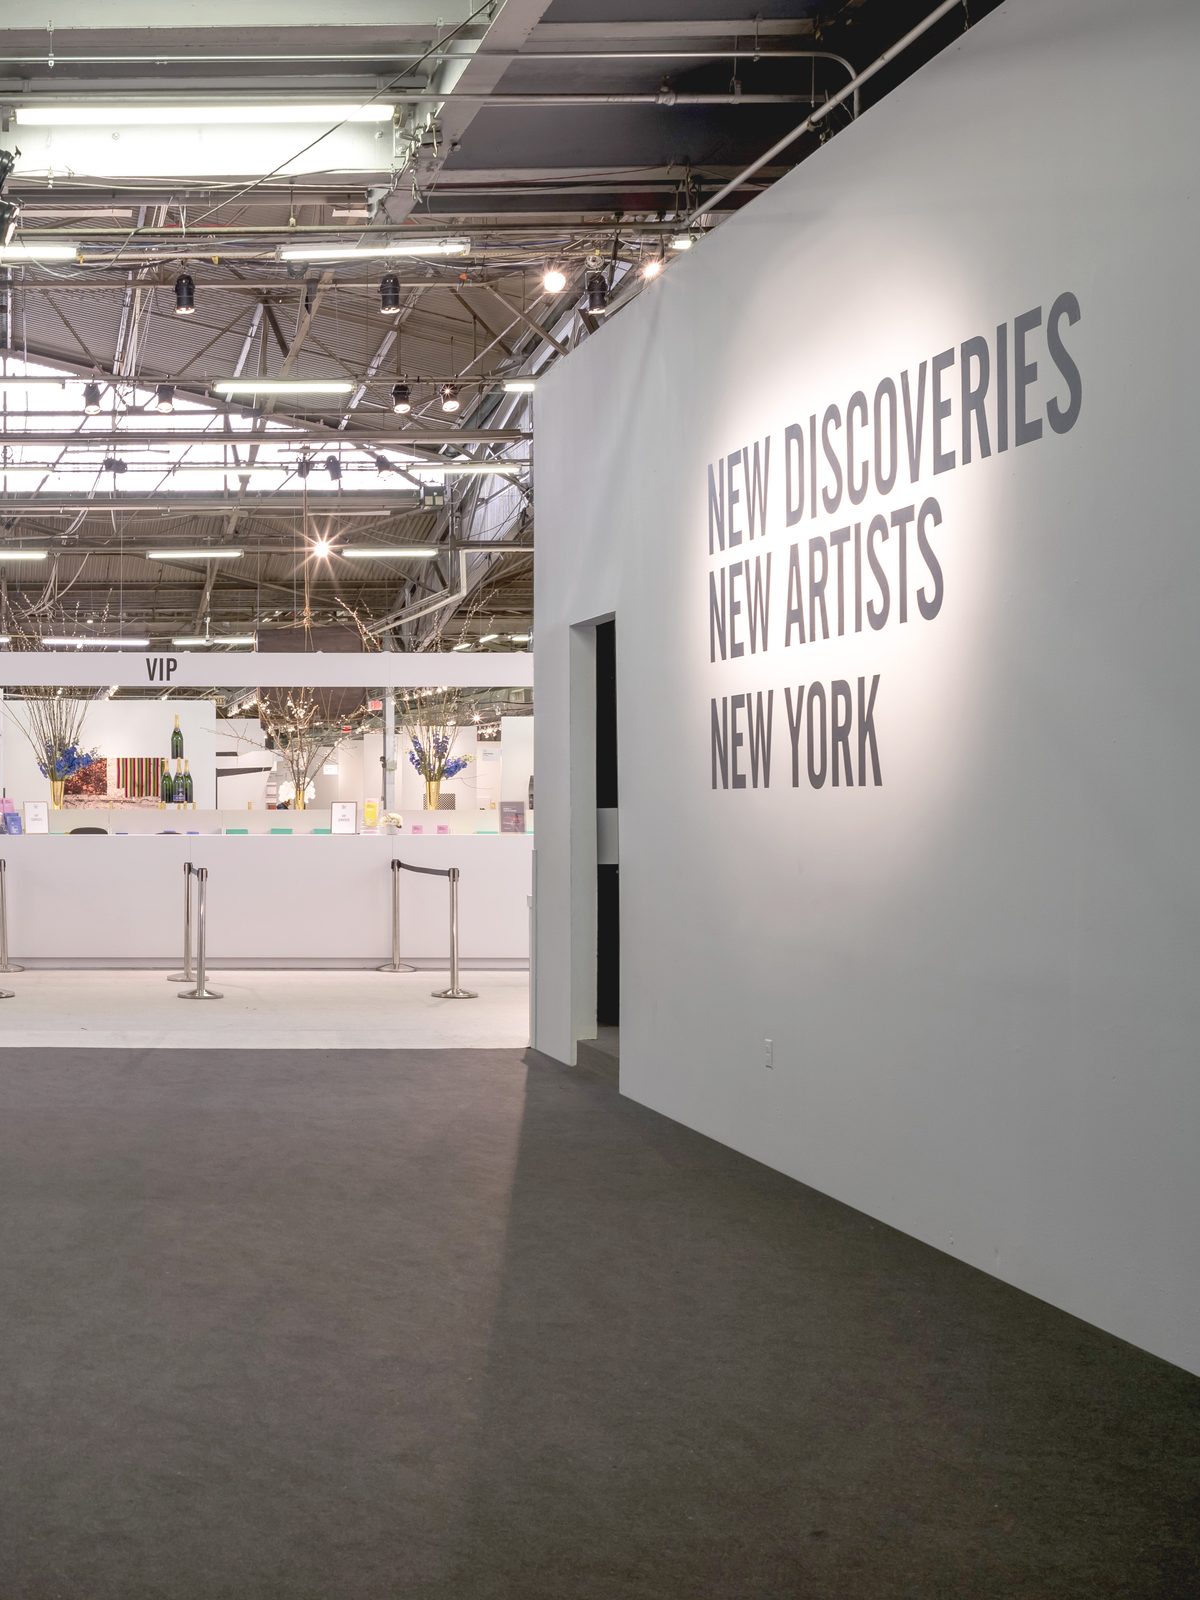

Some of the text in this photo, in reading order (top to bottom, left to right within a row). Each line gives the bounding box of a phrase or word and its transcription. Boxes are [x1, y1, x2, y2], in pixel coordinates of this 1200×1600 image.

[707, 291, 1083, 556] NEW DISCOVERIES
[709, 496, 944, 663] NEW ARTISTS
[145, 657, 178, 682] VIP
[710, 674, 883, 790] NEW YORK
